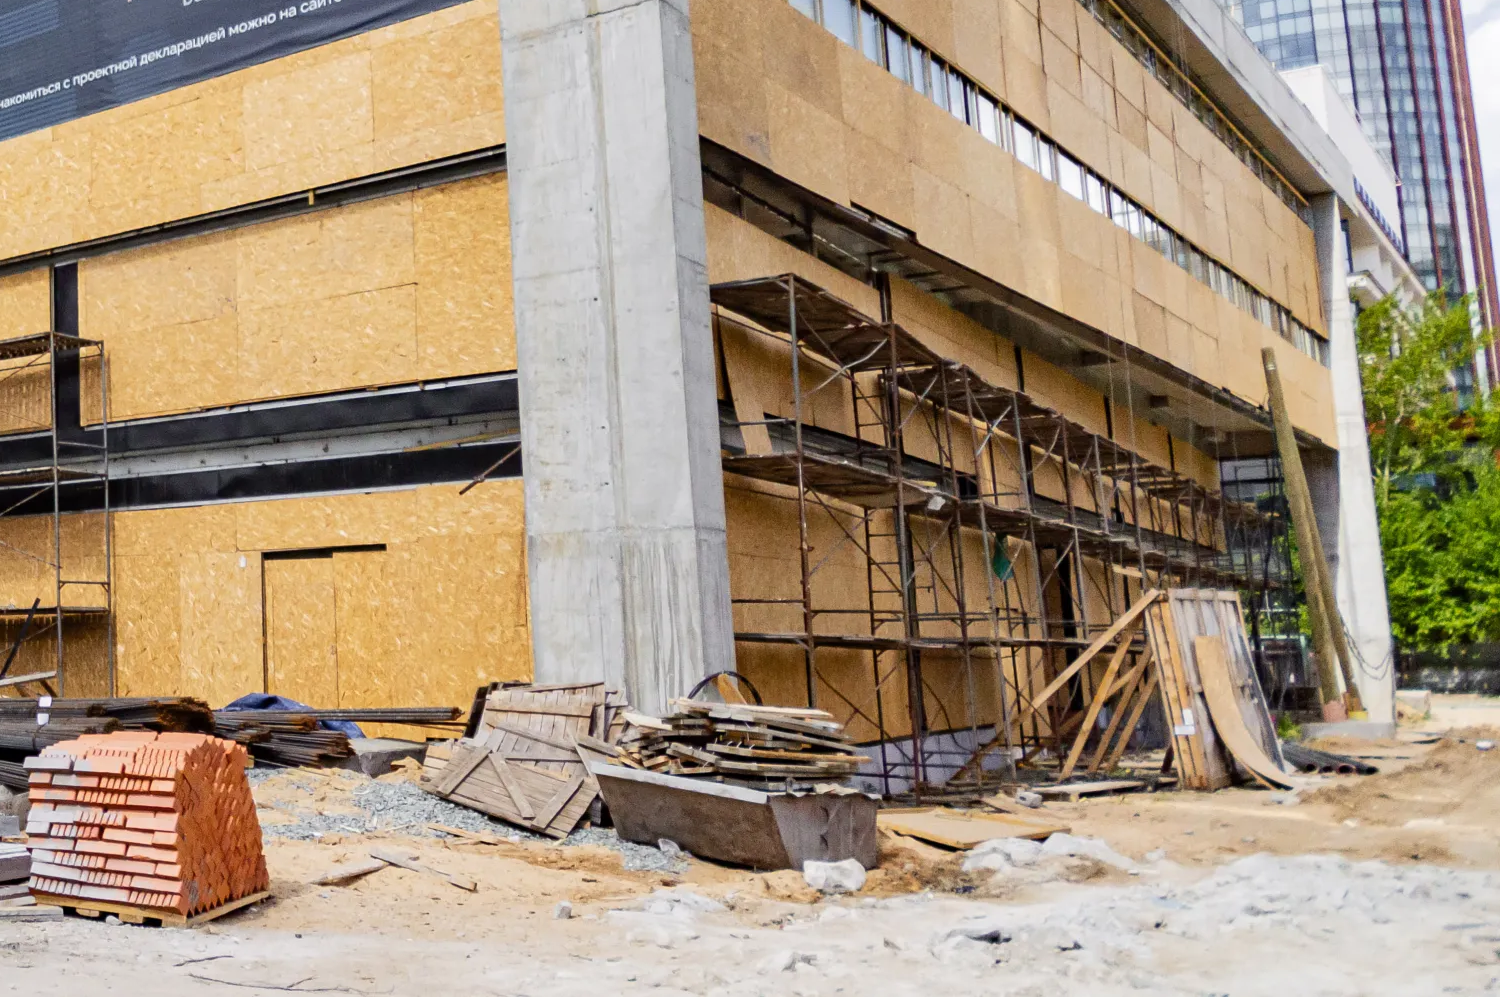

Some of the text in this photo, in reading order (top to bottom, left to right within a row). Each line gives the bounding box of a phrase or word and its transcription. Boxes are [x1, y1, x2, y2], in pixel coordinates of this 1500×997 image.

[63, 79, 71, 89] с
[73, 55, 137, 88] проектной
[139, 27, 226, 67] декларацией
[228, 12, 277, 38] можно
[279, 5, 297, 21] на
